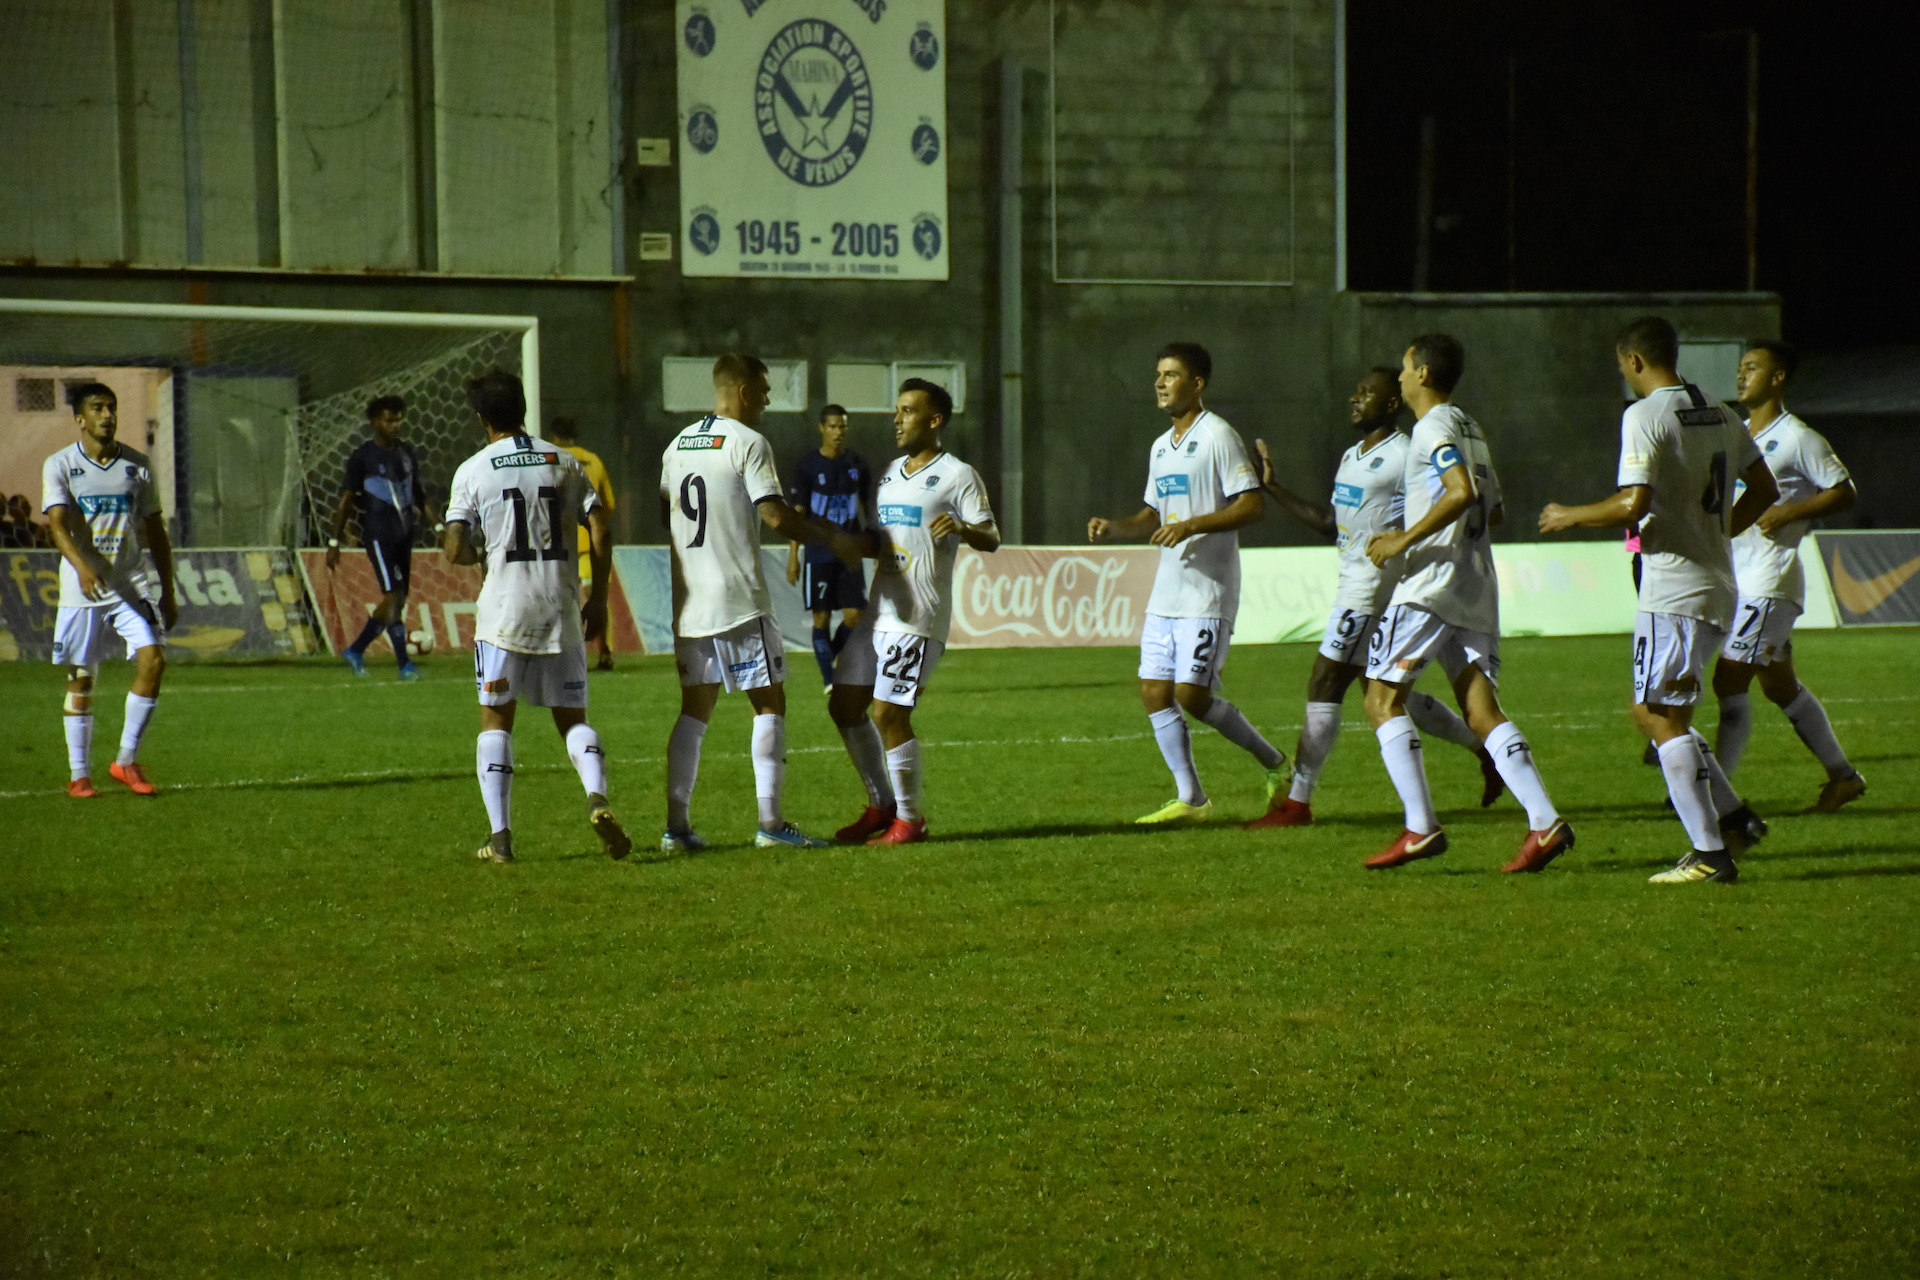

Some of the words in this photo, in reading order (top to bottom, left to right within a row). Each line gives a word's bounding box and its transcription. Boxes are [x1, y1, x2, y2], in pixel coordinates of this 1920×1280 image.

[757, 22, 825, 136] ASSOCIATION
[829, 30, 870, 138] SPORTIVE
[778, 146, 801, 177] DE
[736, 220, 800, 254] 1945
[832, 222, 899, 257] 2005
[679, 436, 714, 449] CARTERS
[1436, 444, 1457, 469] C
[494, 454, 546, 467] CARTERS
[502, 486, 569, 563] 11
[680, 472, 707, 549] 9
[888, 507, 905, 516] CIVIL
[818, 582, 827, 600] 7
[1336, 609, 1355, 637] 6
[1738, 605, 1759, 637] 7
[1193, 629, 1214, 662] 2
[1634, 636, 1647, 675] 4
[882, 645, 921, 682] 22
